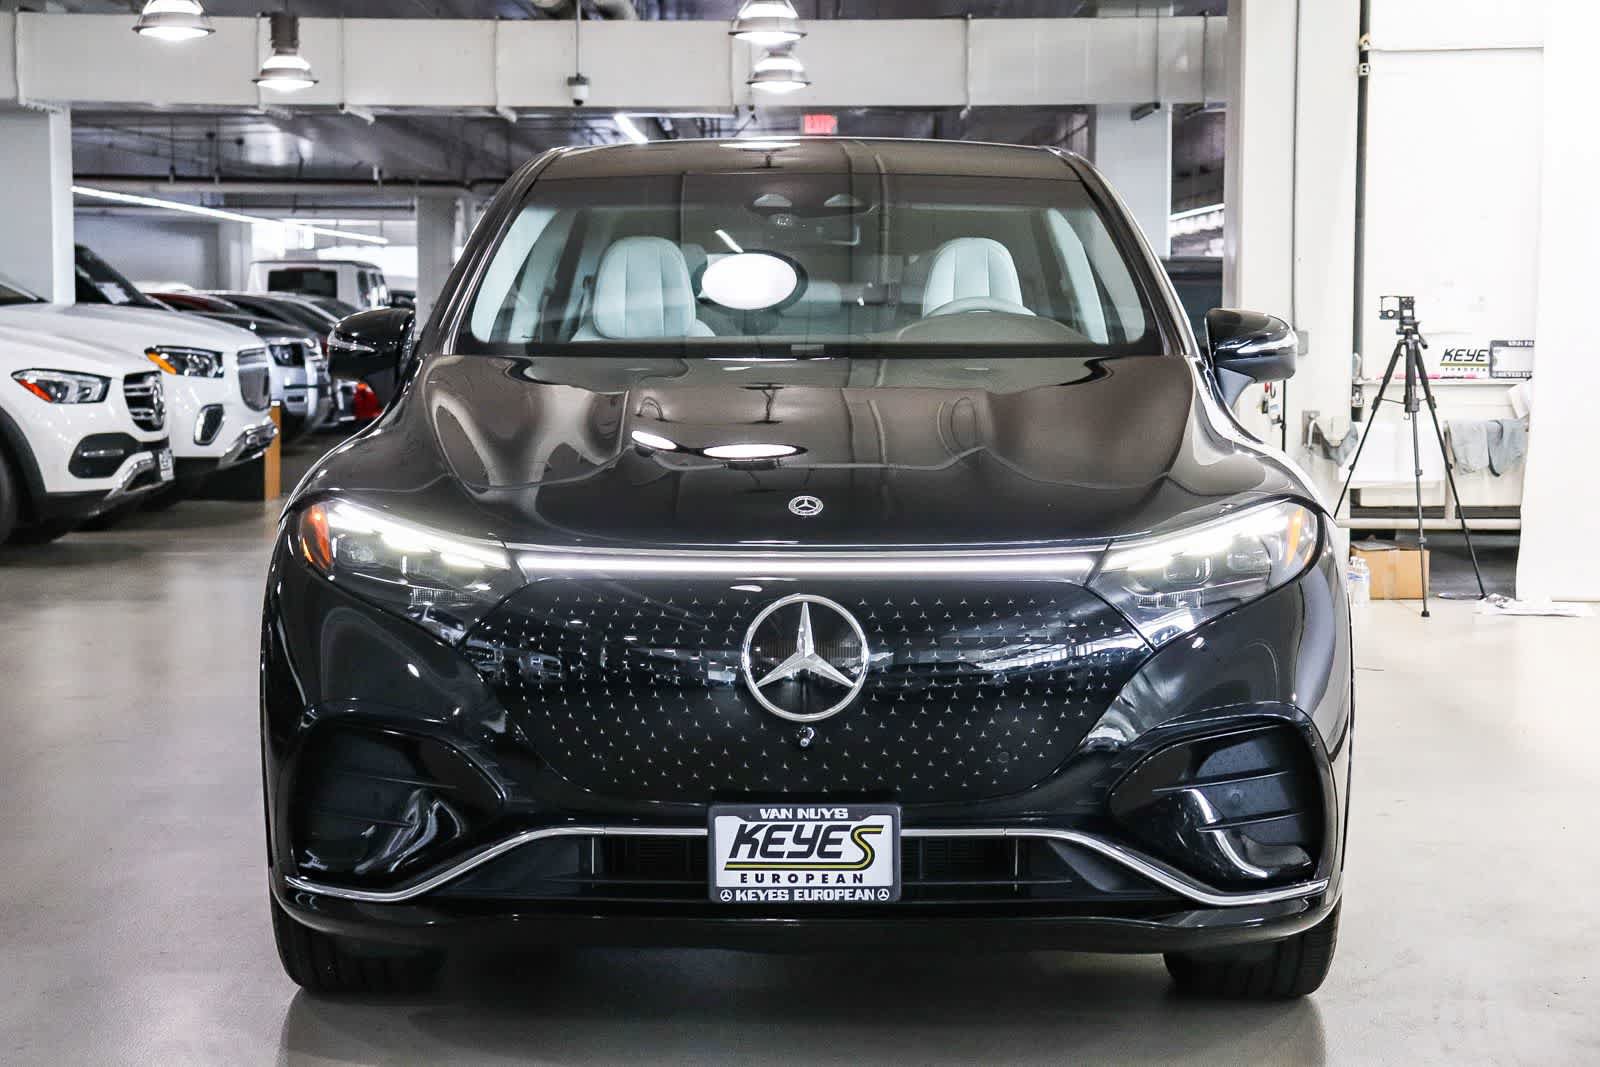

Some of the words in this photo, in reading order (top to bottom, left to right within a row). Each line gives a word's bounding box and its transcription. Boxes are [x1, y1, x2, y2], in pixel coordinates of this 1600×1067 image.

[1441, 348, 1489, 362] KEYE
[760, 808, 792, 819] VAN
[797, 808, 849, 819] NUYS
[726, 823, 884, 871] KEYES
[740, 873, 864, 884] EUROPEAN
[735, 889, 789, 901] KEYES
[794, 888, 875, 901] EUROPEAN
